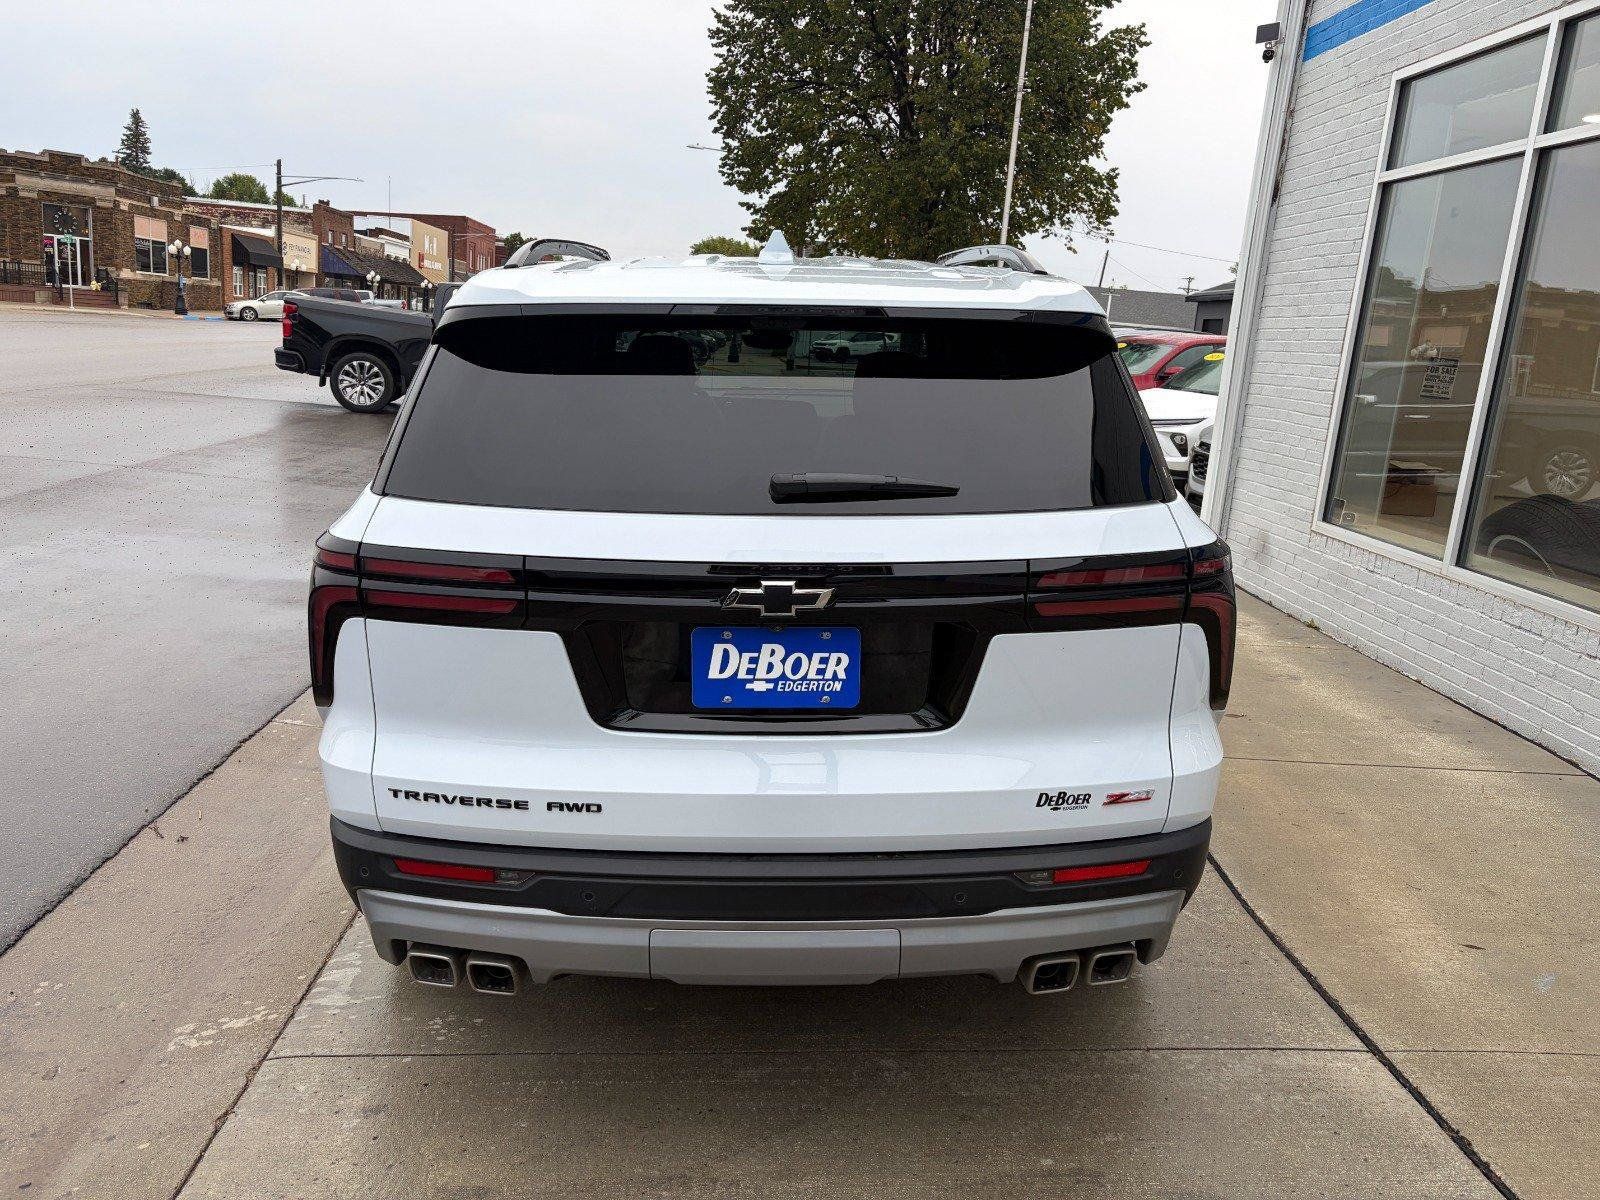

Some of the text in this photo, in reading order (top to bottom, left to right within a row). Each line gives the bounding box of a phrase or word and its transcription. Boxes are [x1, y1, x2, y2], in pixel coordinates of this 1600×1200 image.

[1441, 367, 1457, 375] SALE
[708, 643, 850, 680] DEBOER
[777, 680, 842, 692] EDGERTON
[387, 787, 603, 814] TRAVERSE AWD
[1035, 791, 1092, 808] DEBOER
